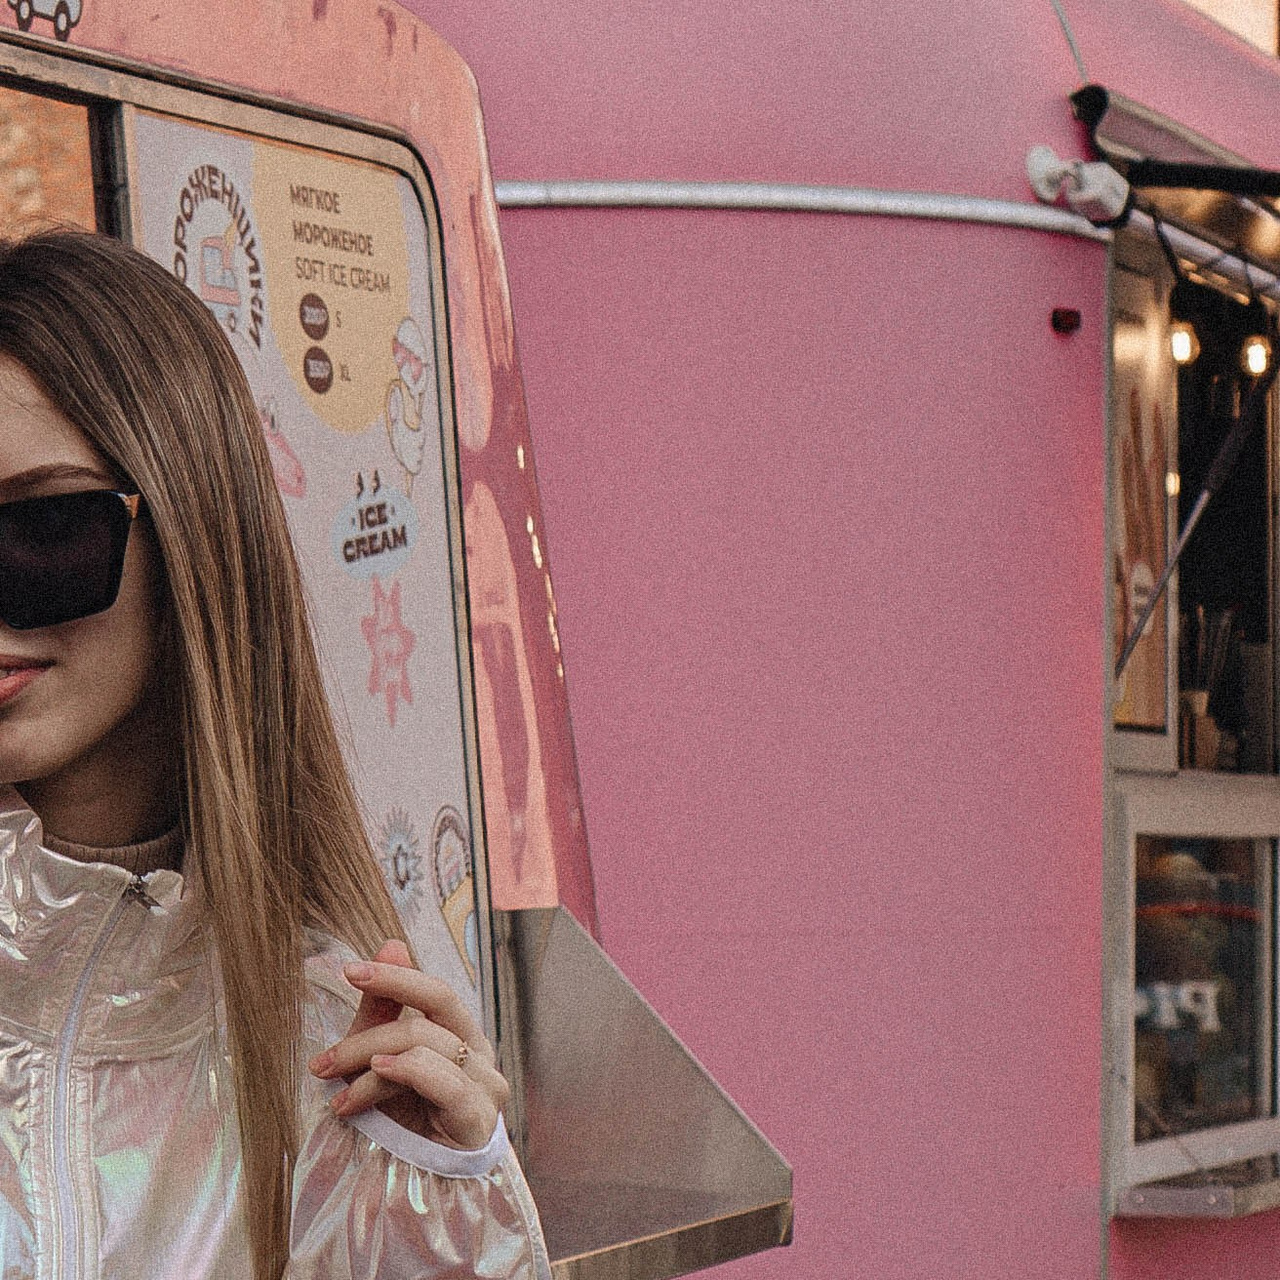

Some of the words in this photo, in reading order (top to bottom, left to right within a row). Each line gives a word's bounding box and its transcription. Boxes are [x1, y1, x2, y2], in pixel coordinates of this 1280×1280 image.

[293, 220, 374, 257] МОРОЖЕНОЕ
[174, 164, 263, 351] ОРОЖЕНЩИКИ
[296, 256, 325, 282] SOFT
[328, 262, 348, 287] ICE
[350, 267, 391, 293] CREAM
[357, 504, 388, 529] ICE
[342, 524, 408, 564] CREAM
